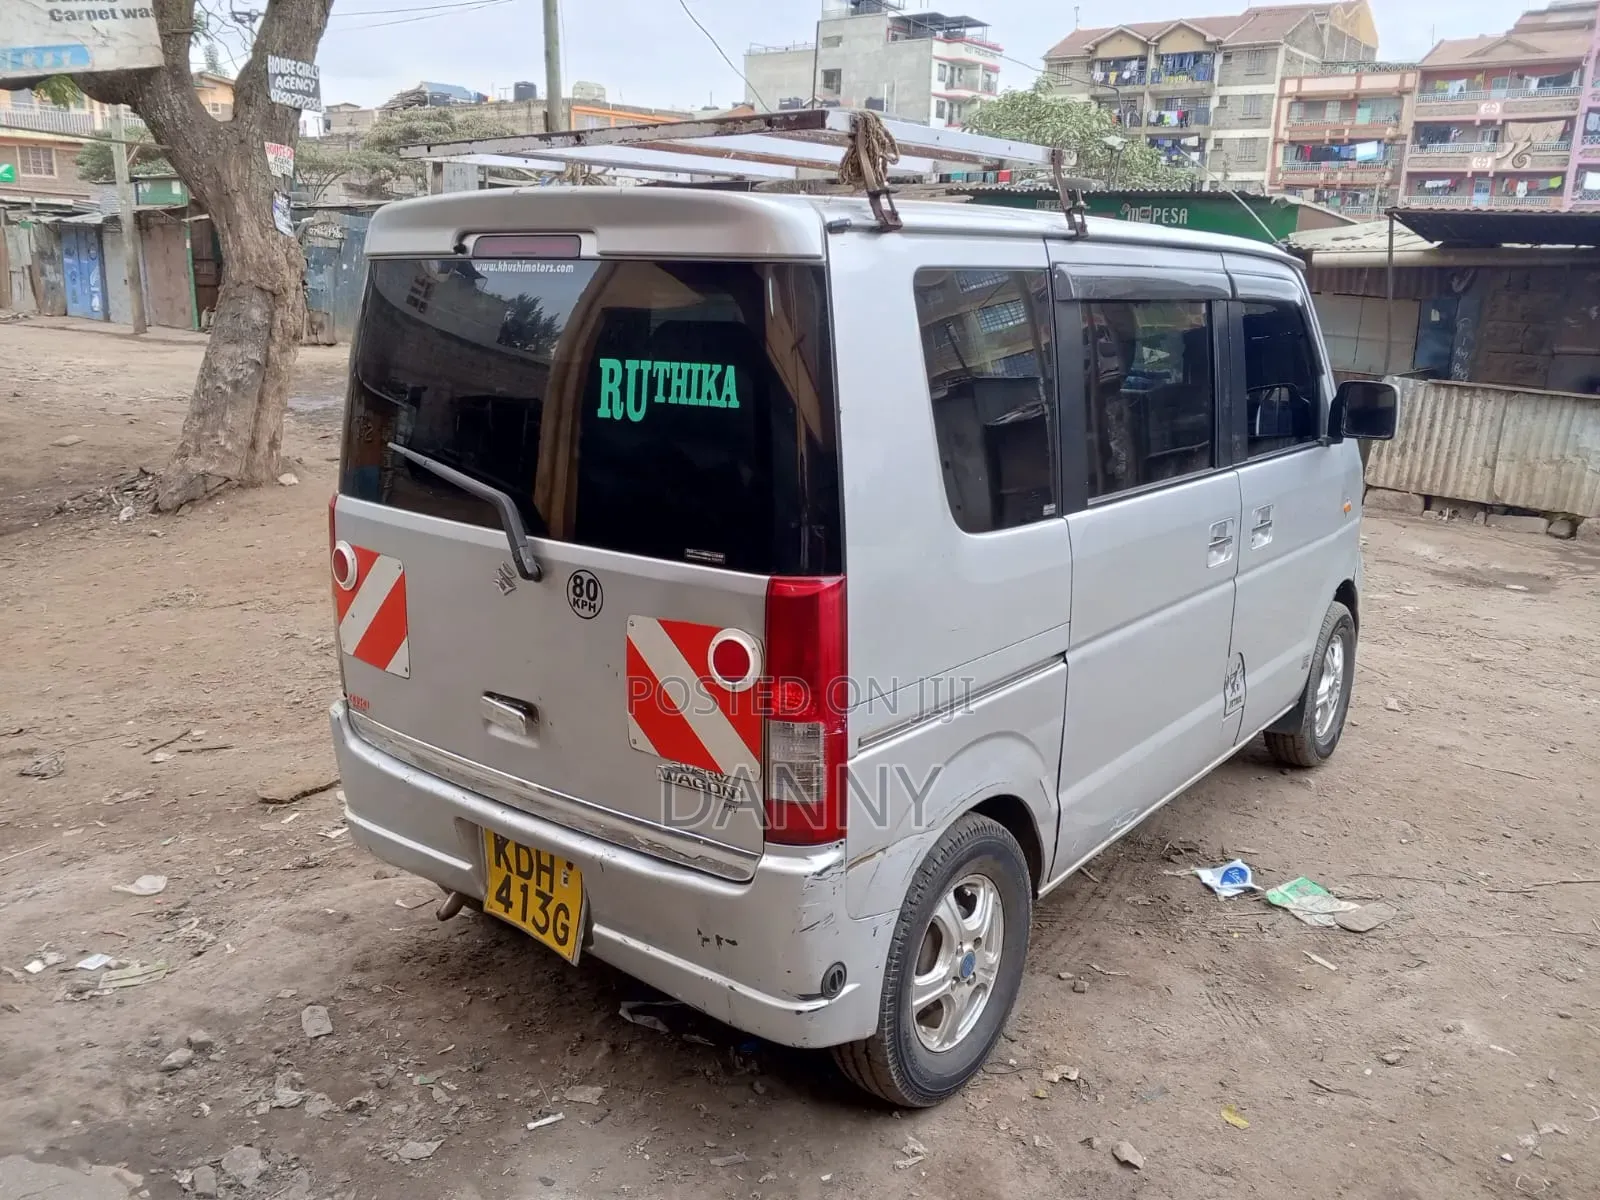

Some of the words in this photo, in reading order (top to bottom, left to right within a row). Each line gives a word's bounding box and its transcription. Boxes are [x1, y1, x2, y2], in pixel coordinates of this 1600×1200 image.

[268, 55, 297, 75] HOUSE
[275, 75, 316, 92] AGENCY
[475, 260, 574, 273] www.khushimotors.com
[597, 358, 740, 422] RUTHIKA
[573, 574, 598, 602] 80
[573, 597, 597, 613] KPH
[657, 767, 738, 800] WAGON
[493, 832, 555, 897] KDH
[495, 873, 570, 946] 413G
